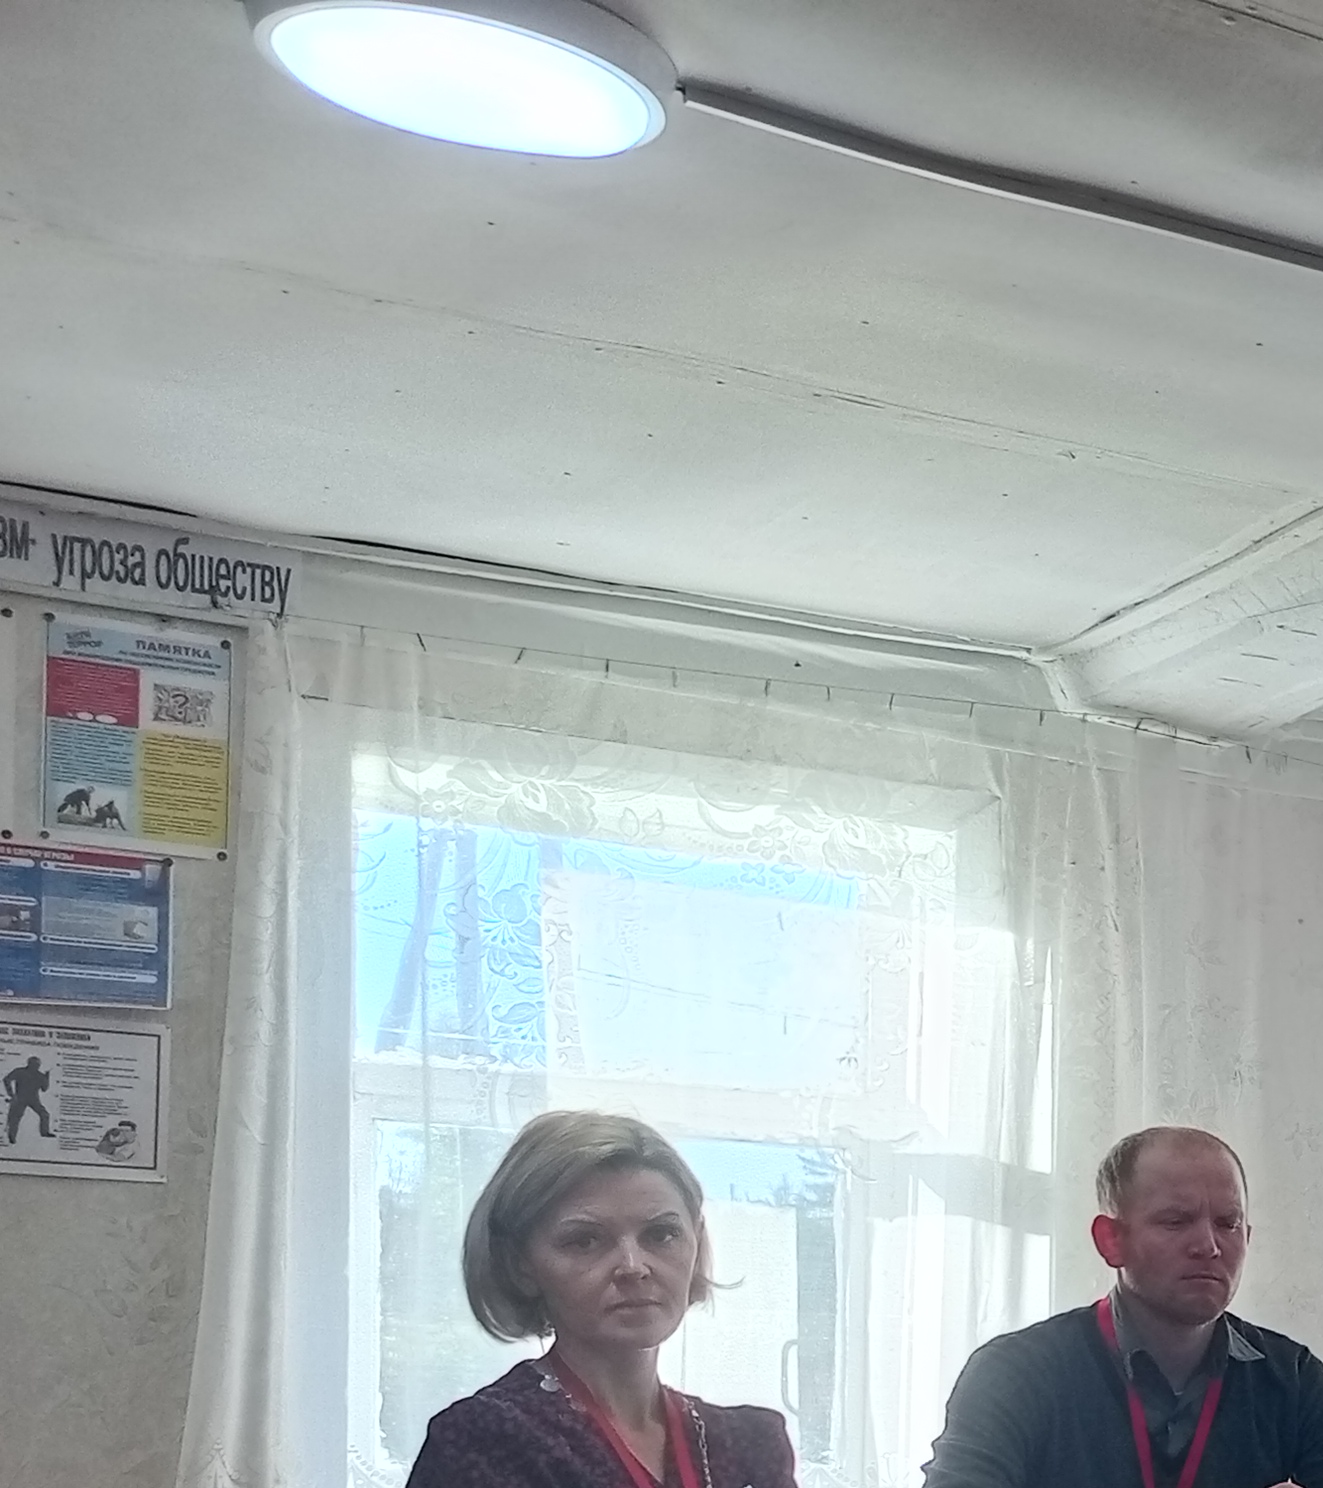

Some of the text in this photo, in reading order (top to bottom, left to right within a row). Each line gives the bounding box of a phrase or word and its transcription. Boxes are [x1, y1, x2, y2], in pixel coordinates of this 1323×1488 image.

[51, 532, 147, 592] угроза
[155, 536, 292, 619] обществу
[135, 639, 212, 660] ПАМЯТКА
